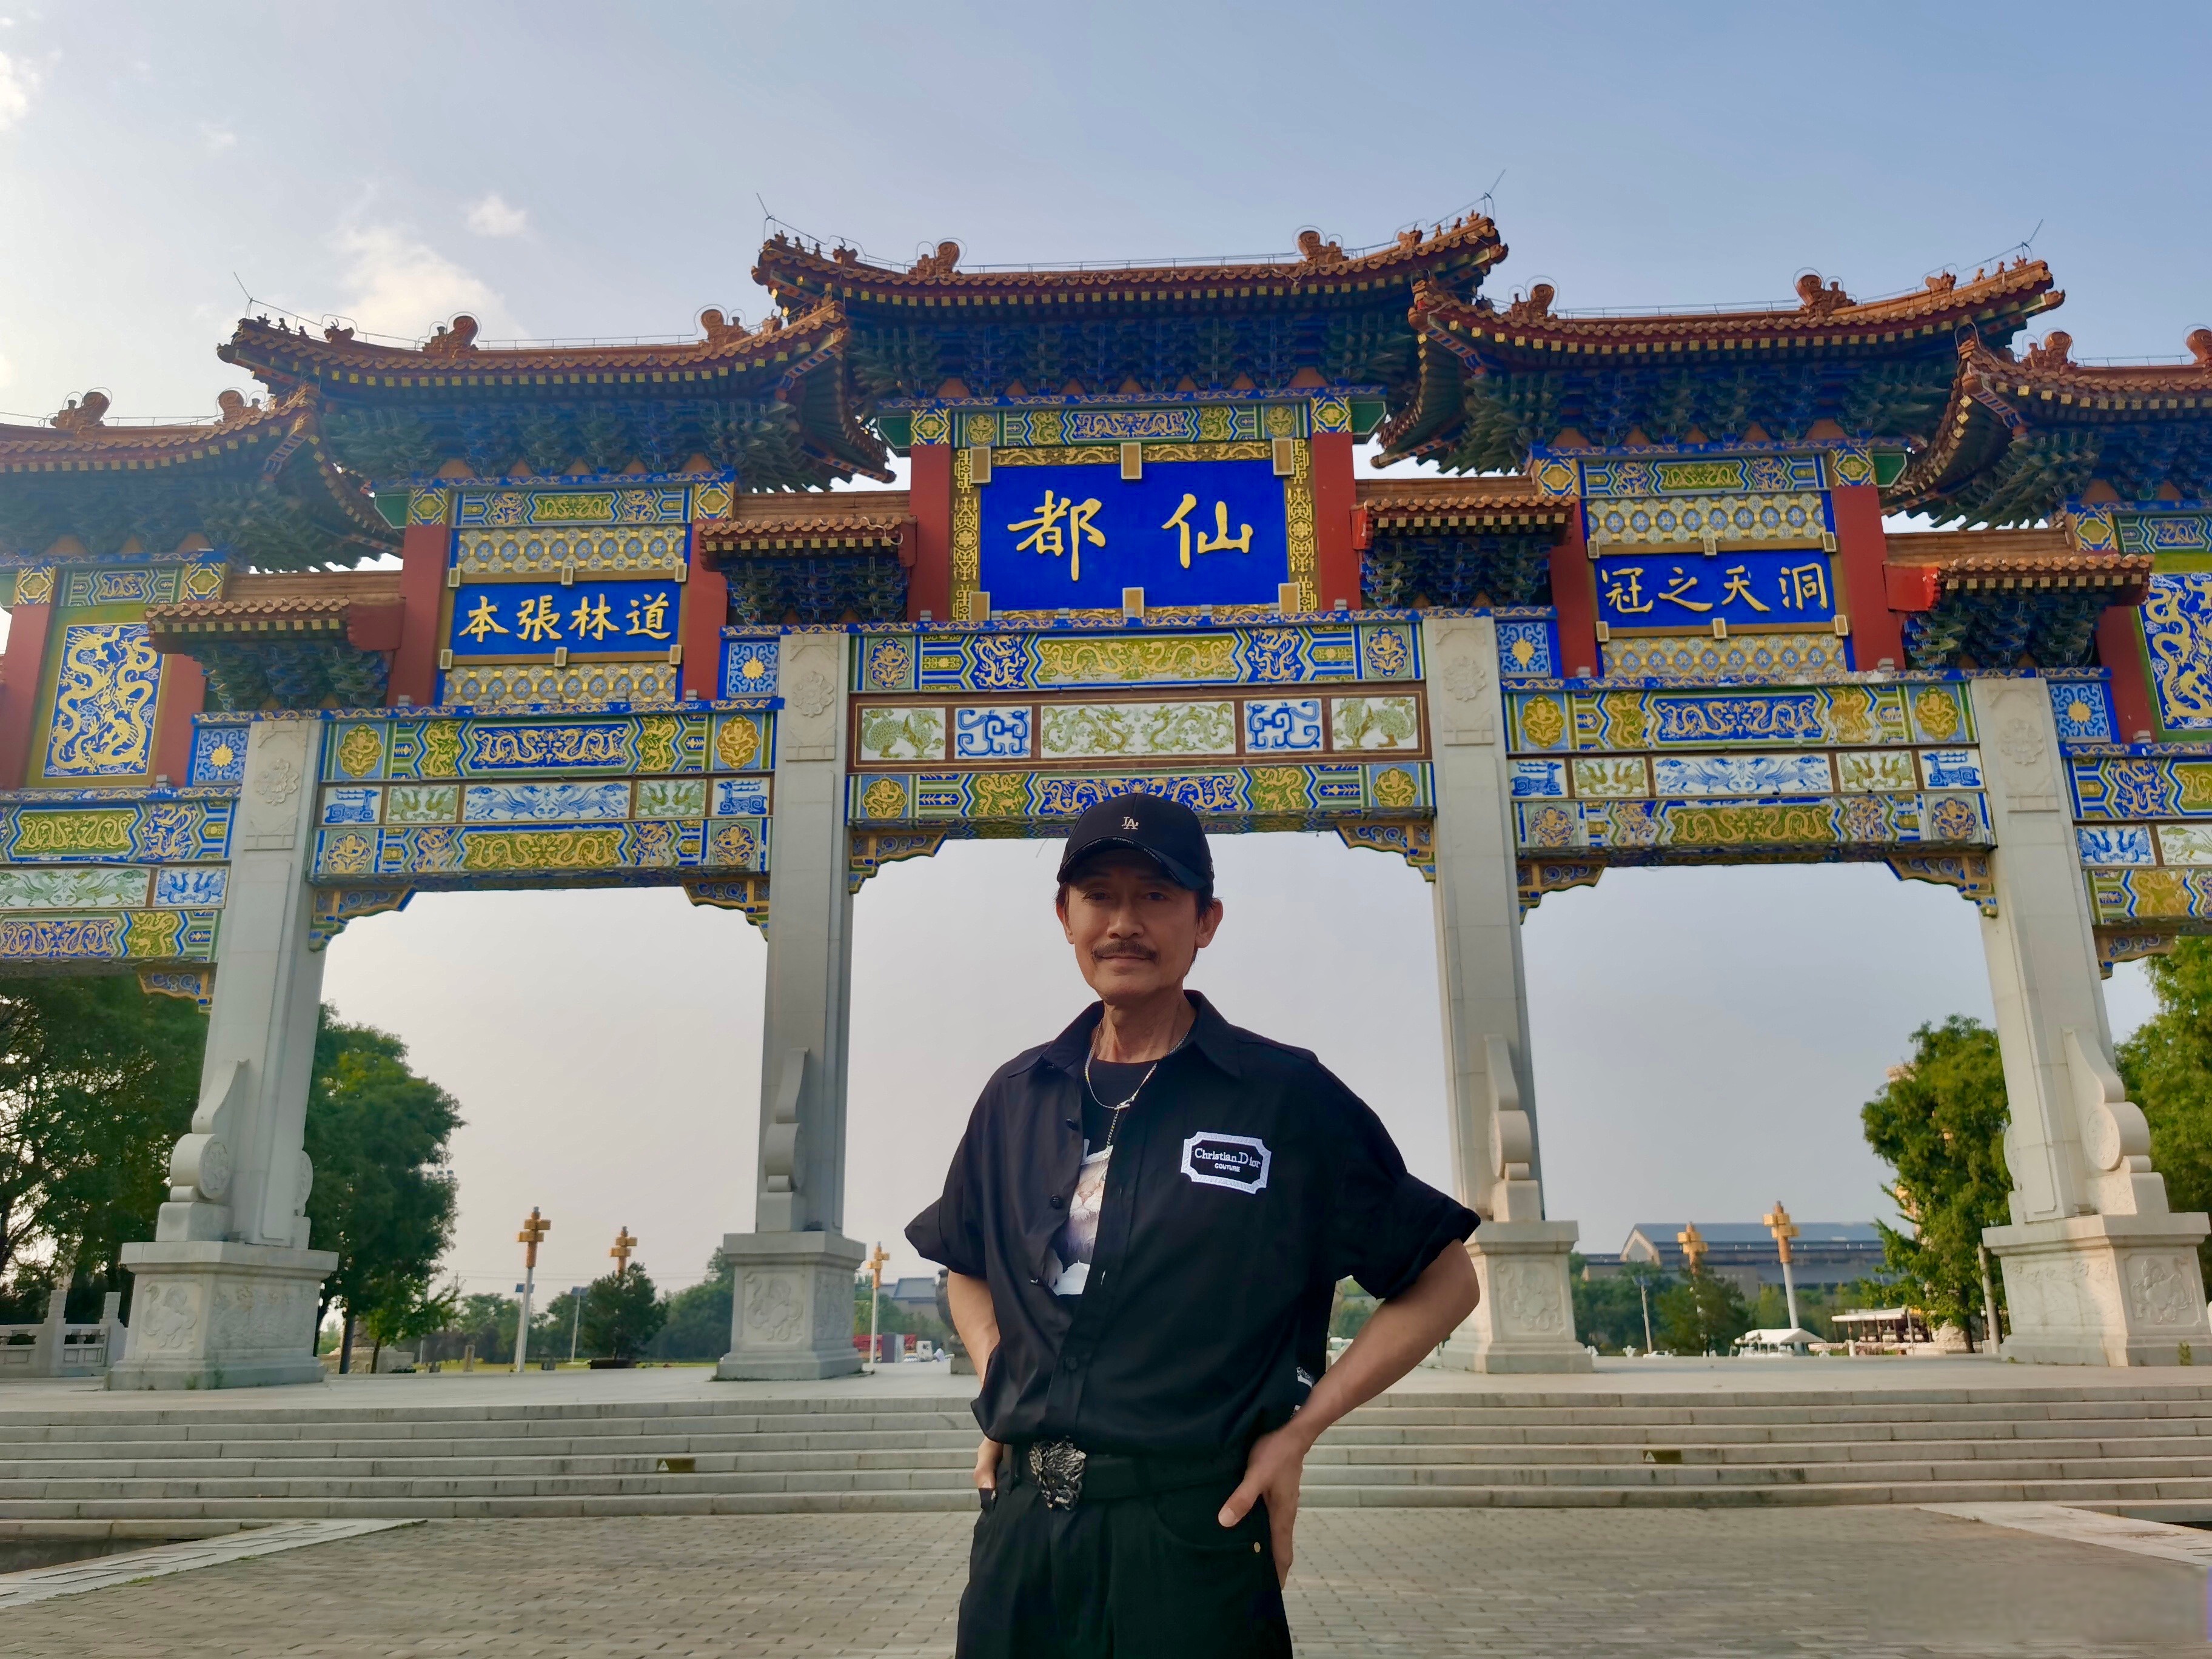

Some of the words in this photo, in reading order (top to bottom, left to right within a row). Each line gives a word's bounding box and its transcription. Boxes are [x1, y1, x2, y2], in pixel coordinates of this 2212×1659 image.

[1121, 816, 1139, 830] LA
[1195, 1147, 1237, 1162] Christian
[1238, 1152, 1261, 1168] Dior
[1215, 1163, 1241, 1172] COUTURE
